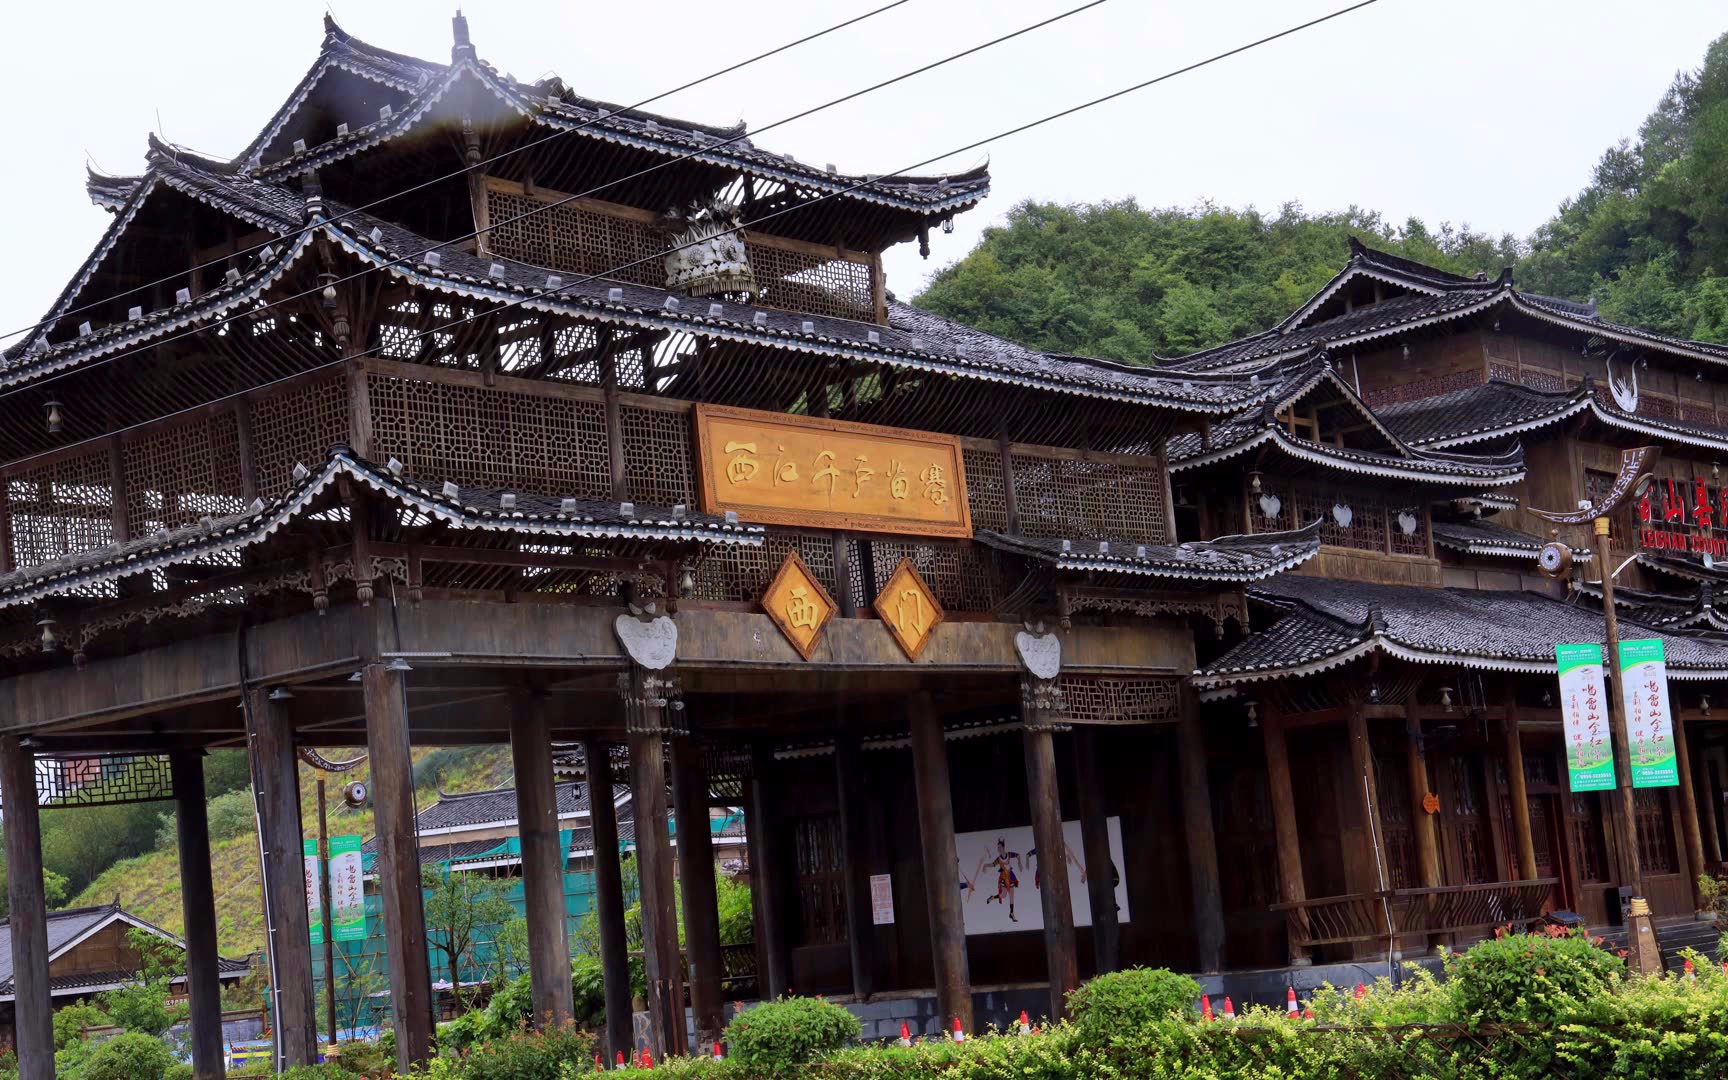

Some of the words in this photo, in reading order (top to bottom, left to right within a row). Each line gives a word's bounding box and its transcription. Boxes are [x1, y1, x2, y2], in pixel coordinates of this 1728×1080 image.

[724, 440, 950, 506] 西江千户苗寨
[1641, 529, 1687, 551] LEISHAN
[1691, 535, 1728, 556] COUNT
[785, 587, 819, 631] 西
[896, 588, 924, 637] 门
